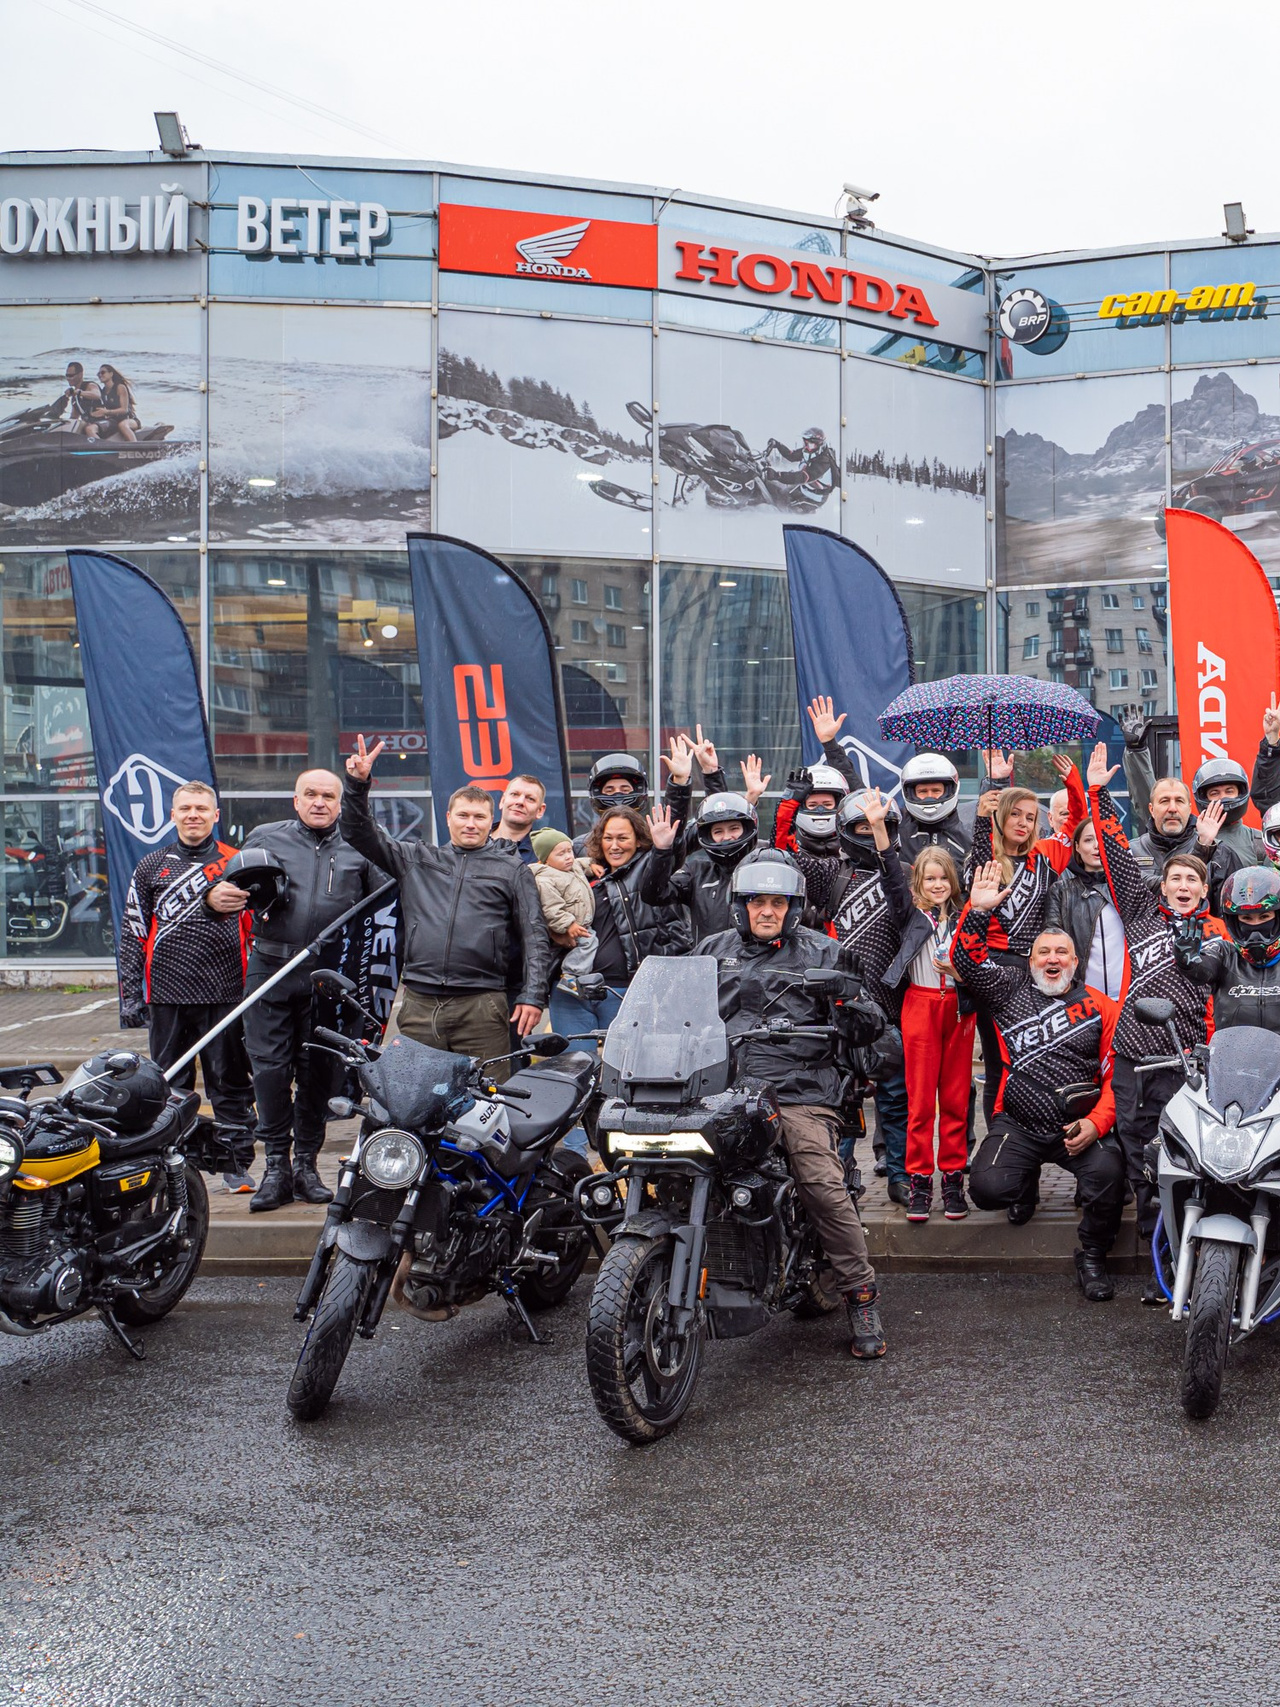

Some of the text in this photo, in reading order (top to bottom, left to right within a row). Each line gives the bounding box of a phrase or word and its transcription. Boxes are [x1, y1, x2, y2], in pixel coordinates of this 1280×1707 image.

[0, 183, 390, 257] ОЖНЫЙ ВЕТЕР
[515, 261, 592, 280] HONDA
[675, 241, 940, 327] HONDA
[1098, 281, 1256, 320] can-am
[1018, 313, 1047, 328] BRP
